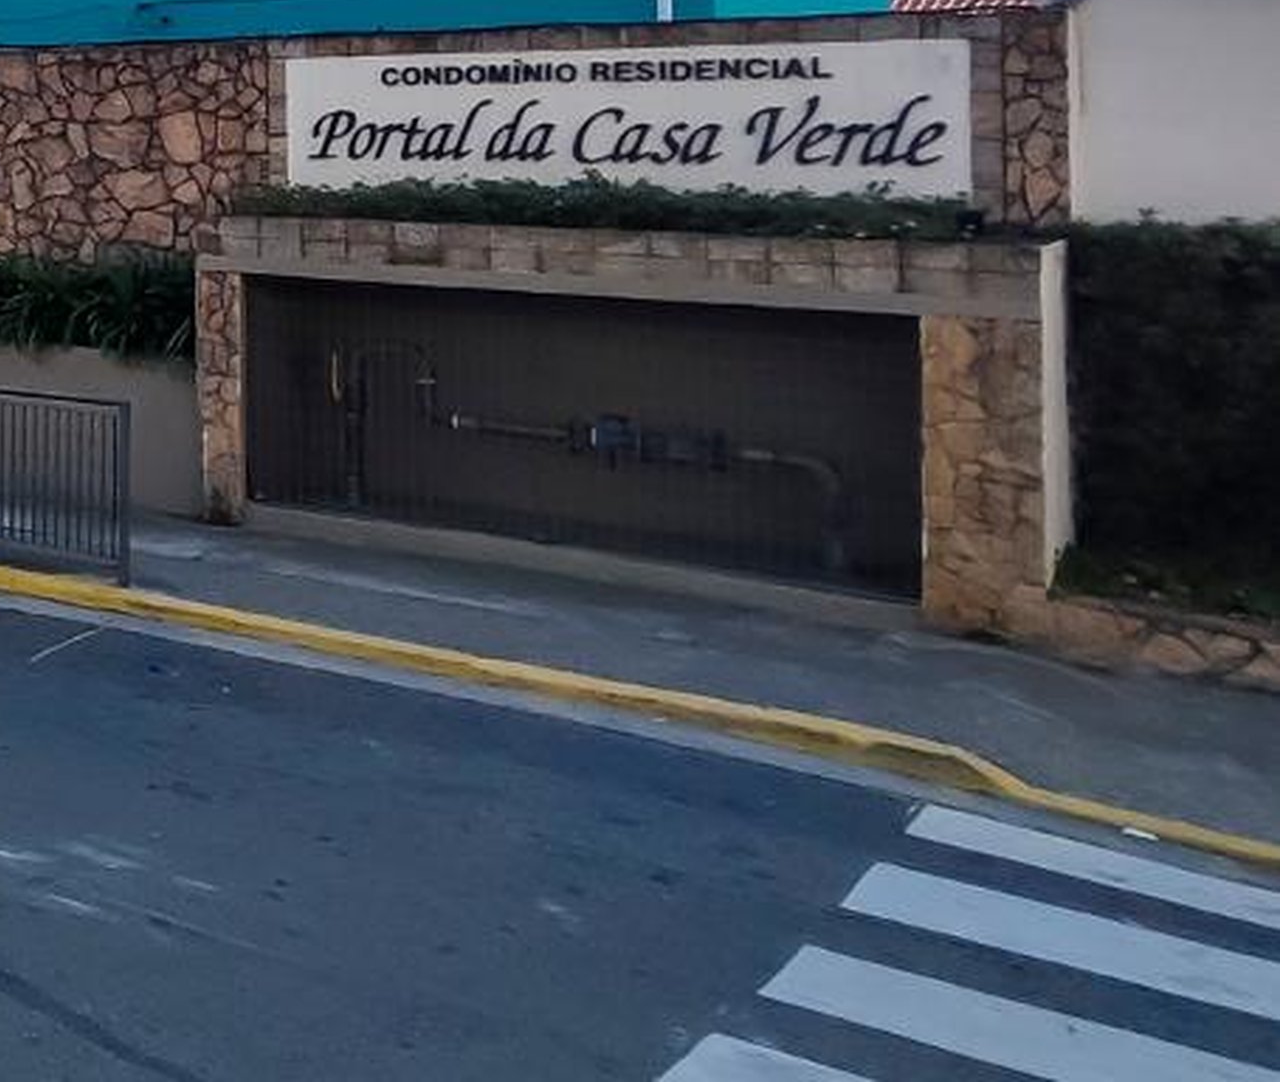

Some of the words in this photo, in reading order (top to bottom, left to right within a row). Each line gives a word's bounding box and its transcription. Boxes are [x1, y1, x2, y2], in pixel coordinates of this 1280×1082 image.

[590, 56, 833, 83] RESIDENCIAL
[308, 98, 493, 161] Portal
[485, 98, 555, 161] da
[572, 107, 723, 165] Casa
[745, 95, 948, 167] Verde
